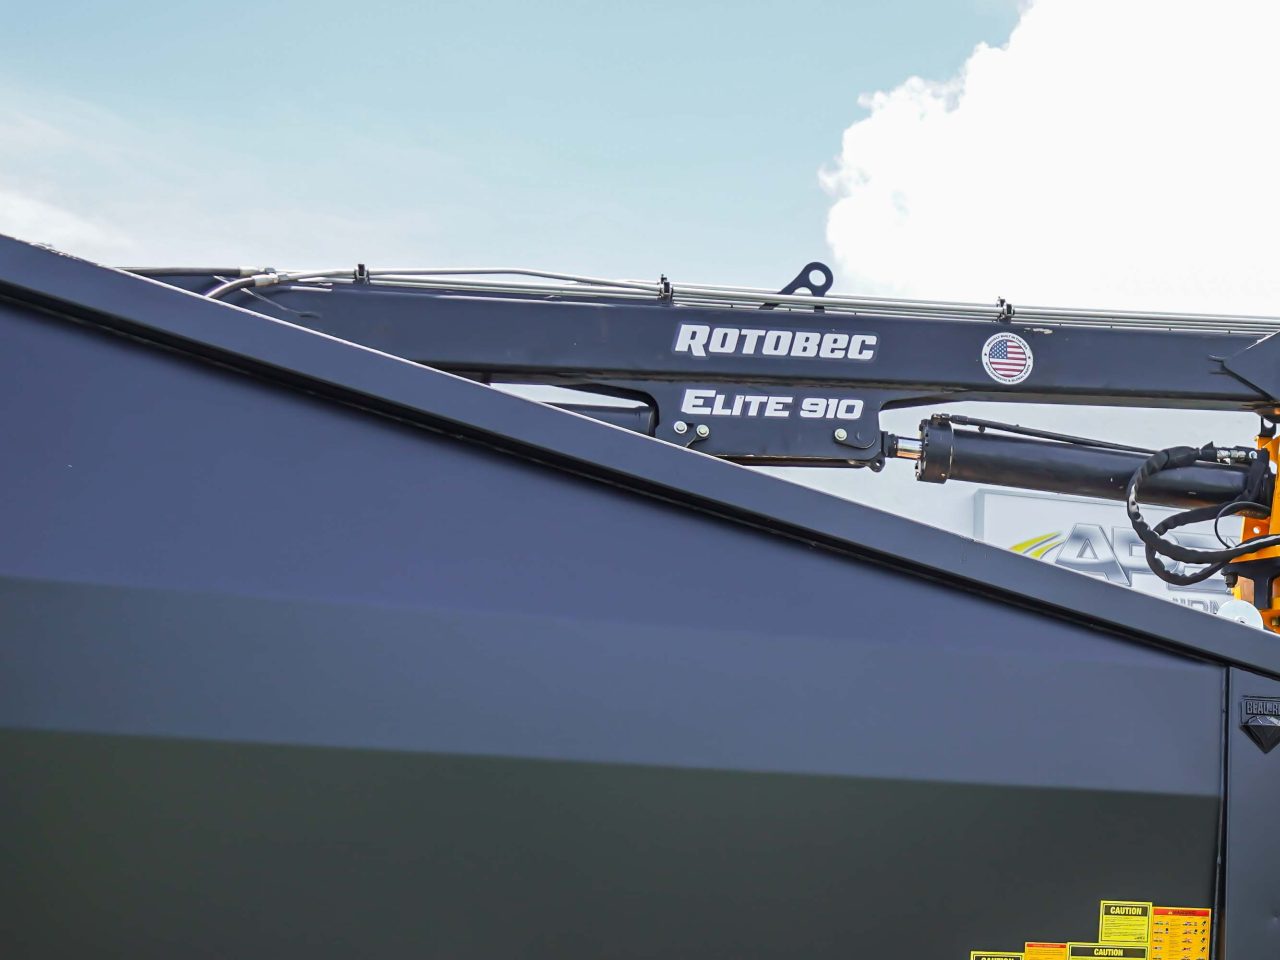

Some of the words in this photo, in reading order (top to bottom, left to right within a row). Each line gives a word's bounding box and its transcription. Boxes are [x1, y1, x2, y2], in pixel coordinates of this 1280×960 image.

[681, 389, 793, 418] ELITE
[800, 397, 864, 419] 910
[1110, 907, 1142, 915] CAUTION
[1094, 948, 1123, 956] CAUTION
